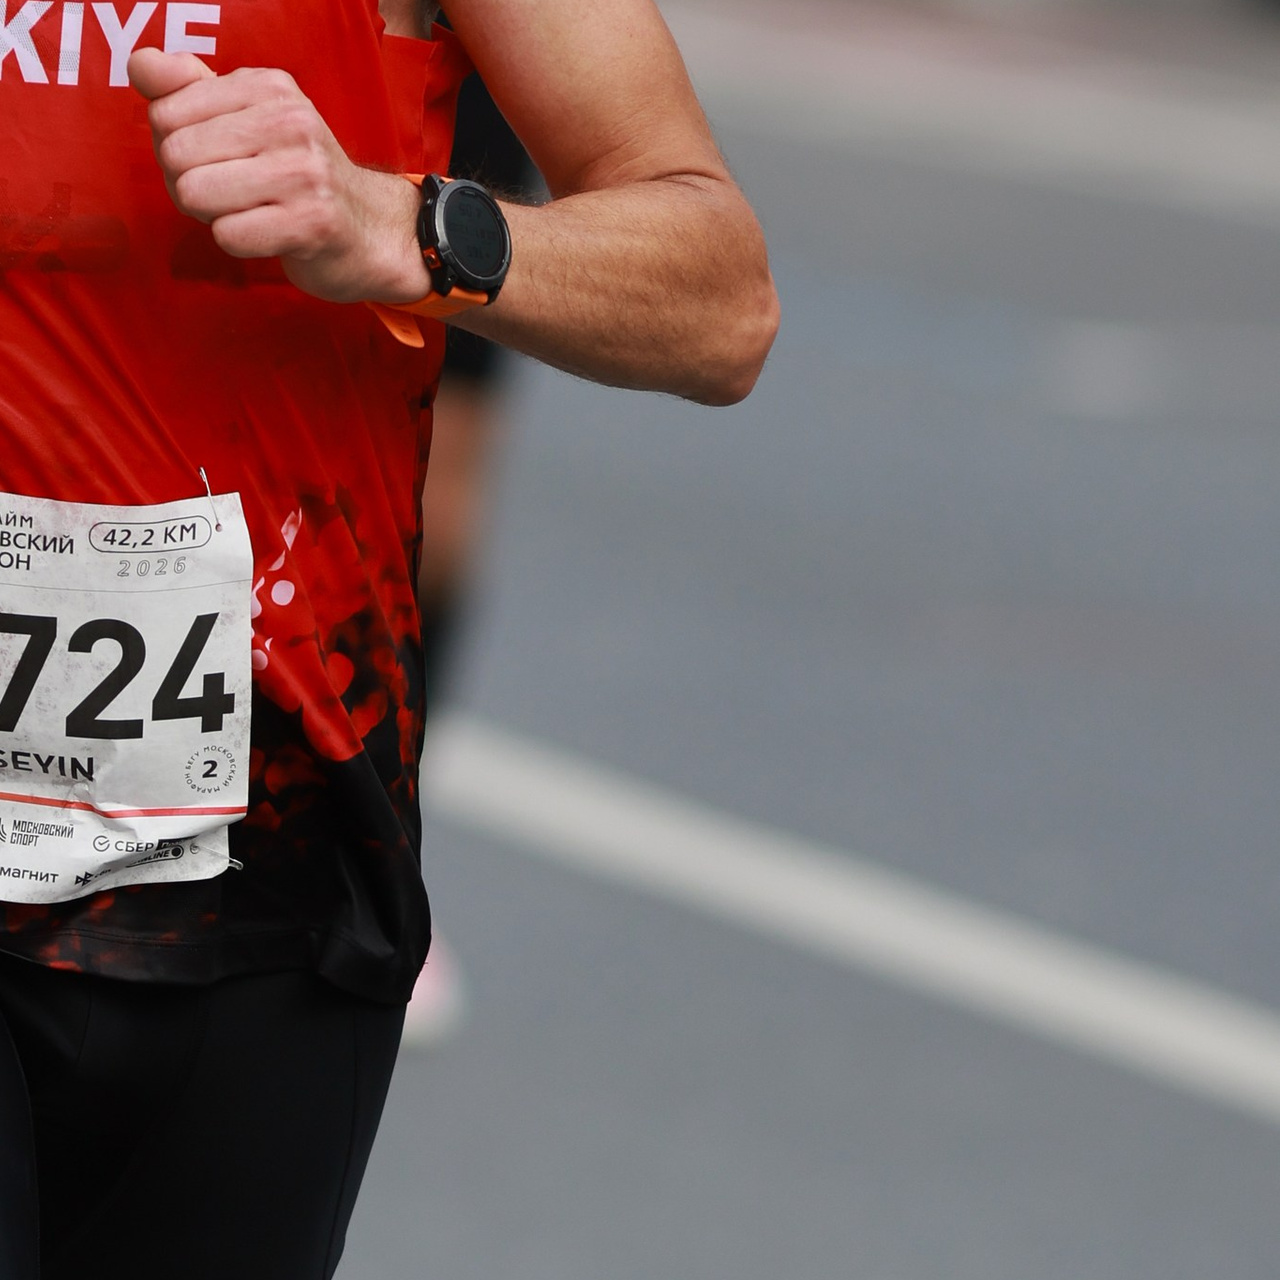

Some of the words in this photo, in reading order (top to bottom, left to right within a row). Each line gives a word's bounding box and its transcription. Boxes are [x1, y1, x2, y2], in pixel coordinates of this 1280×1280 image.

[103, 529, 155, 548] 42,2
[117, 556, 186, 577] 2026
[202, 760, 218, 778] 2
[12, 820, 75, 839] МОСКОВСКИЙ
[10, 832, 40, 847] СПОРТ
[114, 840, 154, 853] СБЕР
